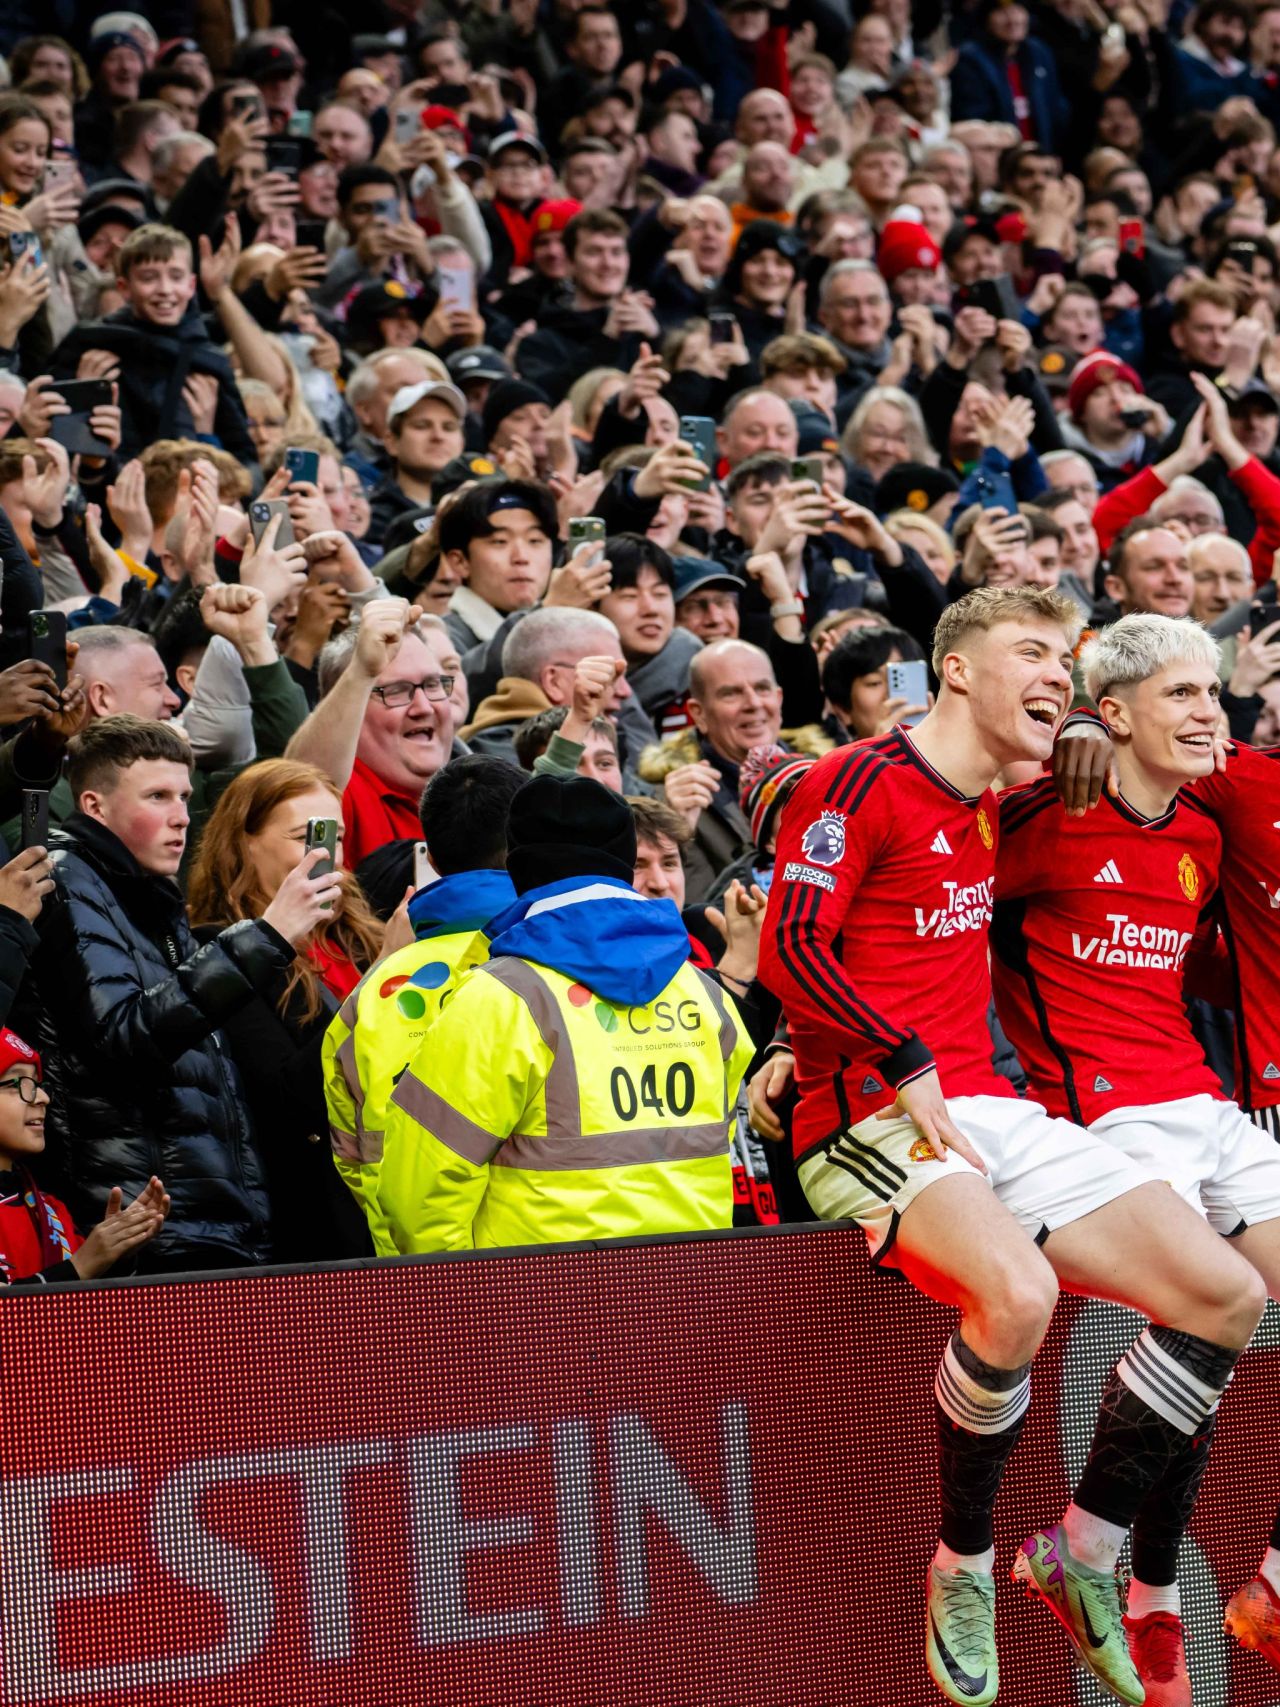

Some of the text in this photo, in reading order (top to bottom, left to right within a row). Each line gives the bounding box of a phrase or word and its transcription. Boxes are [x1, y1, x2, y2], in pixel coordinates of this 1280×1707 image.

[784, 872, 835, 893] for racism
[785, 863, 832, 883] No room
[1071, 932, 1174, 970] Viewer
[1105, 913, 1179, 953] Team
[627, 999, 701, 1035] CSG
[645, 1042, 682, 1051] SOLUTIONS
[683, 1040, 706, 1048] GROUP
[610, 1061, 696, 1122] 040
